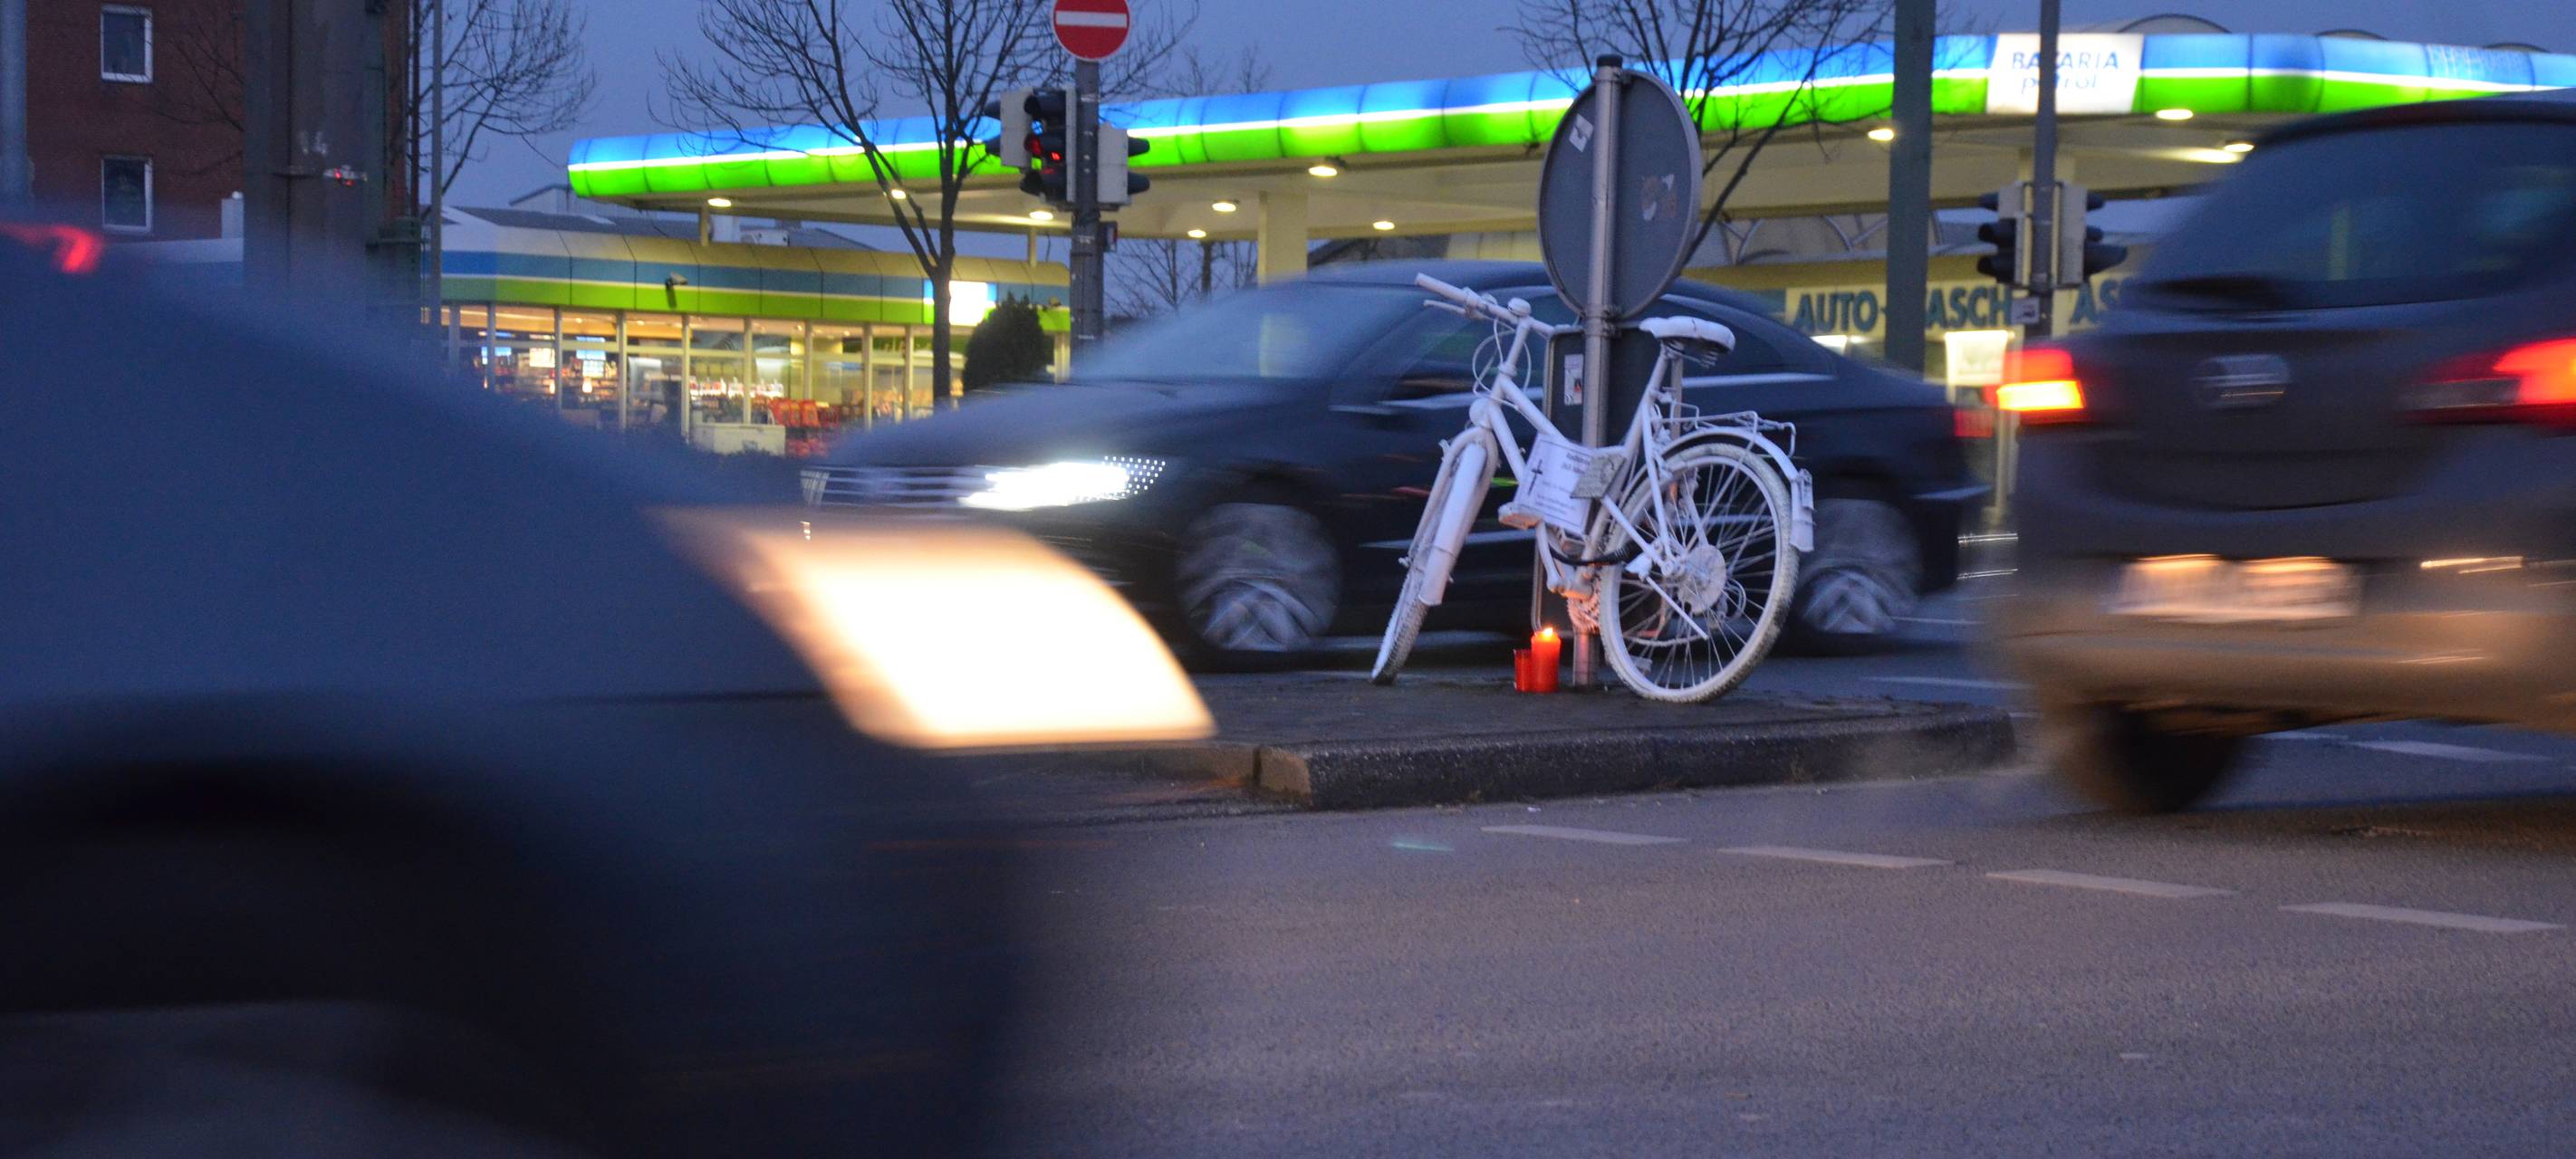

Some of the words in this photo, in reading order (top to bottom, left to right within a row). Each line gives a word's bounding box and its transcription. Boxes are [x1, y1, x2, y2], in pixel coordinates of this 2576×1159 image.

[2012, 51, 2119, 70] BAARIA
[2021, 72, 2098, 94] ptrol
[1793, 285, 2013, 333] AUTO-ASCH
